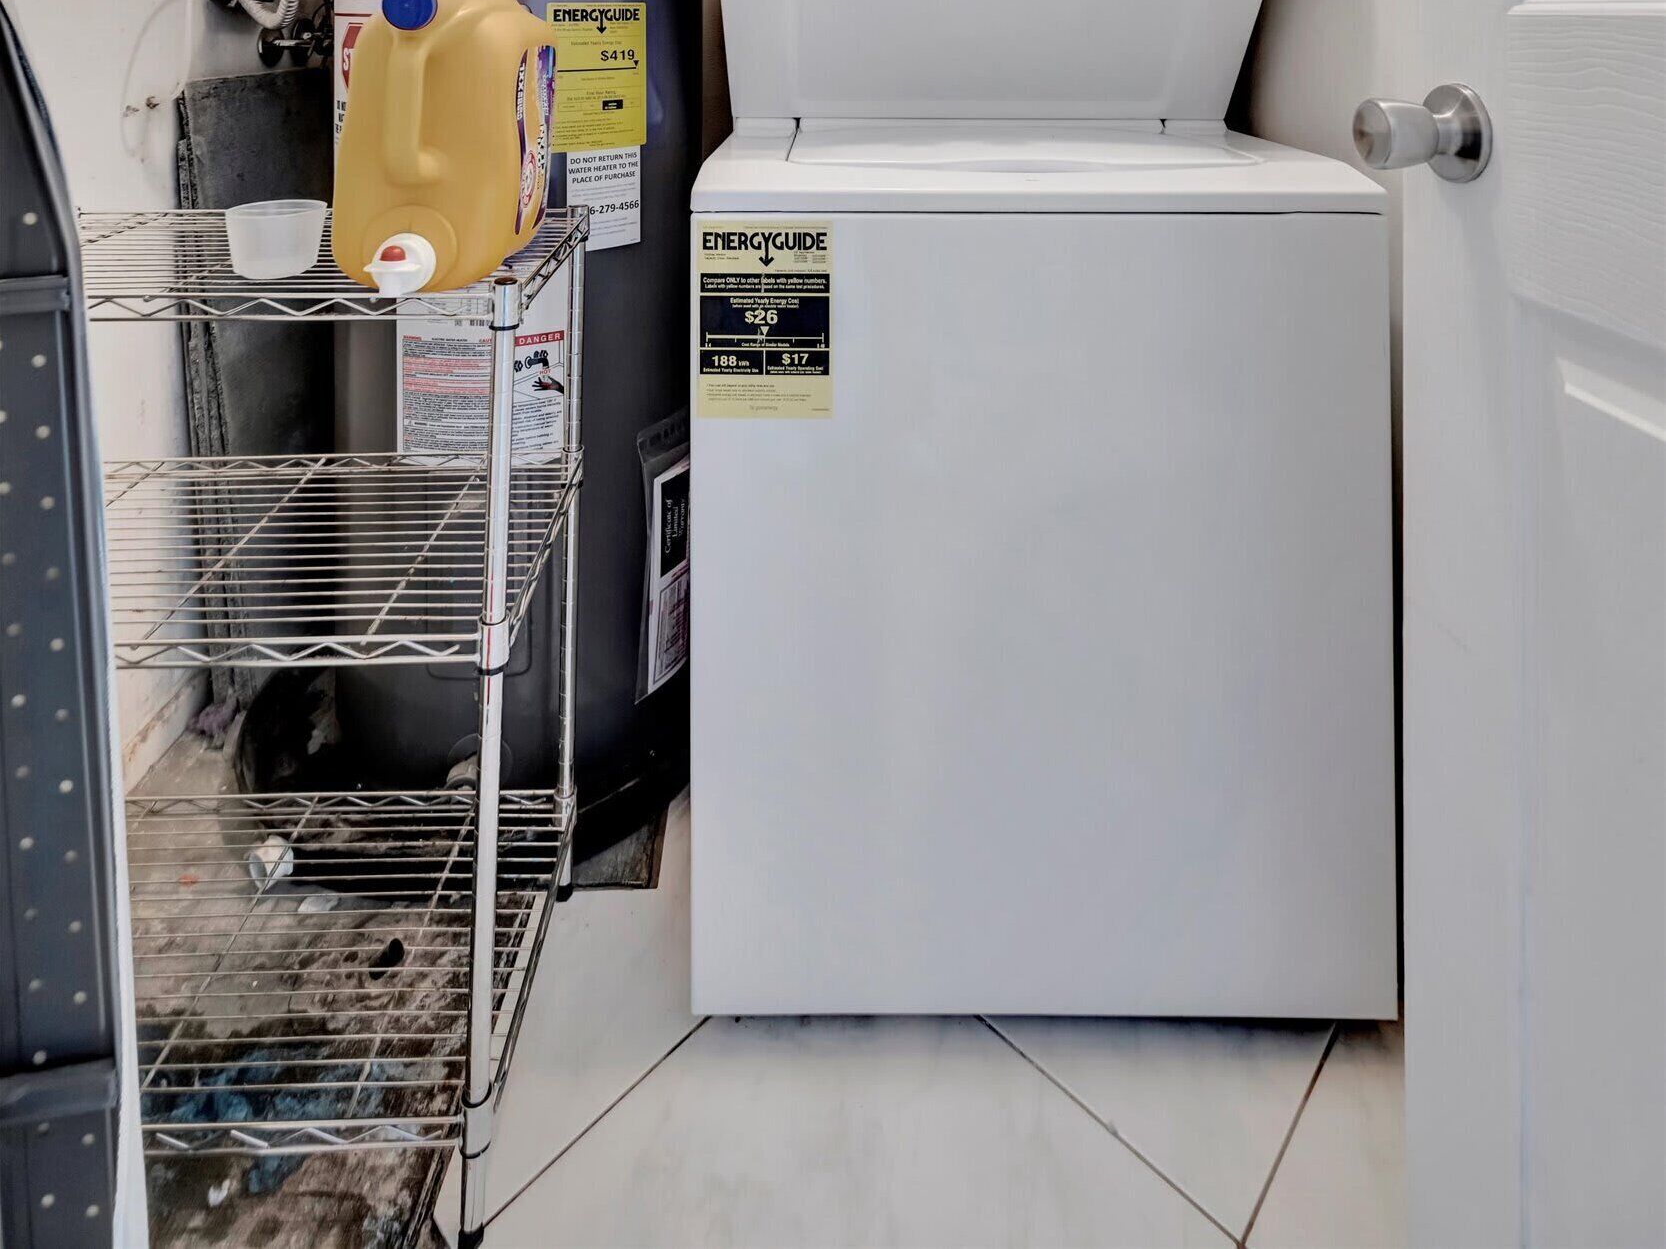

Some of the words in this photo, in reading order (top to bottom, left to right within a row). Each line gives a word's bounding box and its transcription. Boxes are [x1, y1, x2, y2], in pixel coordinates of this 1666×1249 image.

[553, 8, 640, 22] ENERGYGUIDE
[600, 49, 635, 61] $419
[582, 156, 596, 164] NOT
[598, 154, 623, 162] RETURN
[568, 167, 592, 175] WATER
[593, 164, 617, 172] HEATER
[572, 176, 592, 184] PLACE
[604, 171, 636, 180] PURCHASE
[589, 200, 640, 215] 6-279-4566
[703, 232, 827, 251] ENERGYGUIDE
[788, 277, 803, 285] yellow
[744, 310, 778, 324] $26
[519, 332, 561, 345] DANGER
[712, 355, 737, 366] 188
[781, 353, 809, 365] $17
